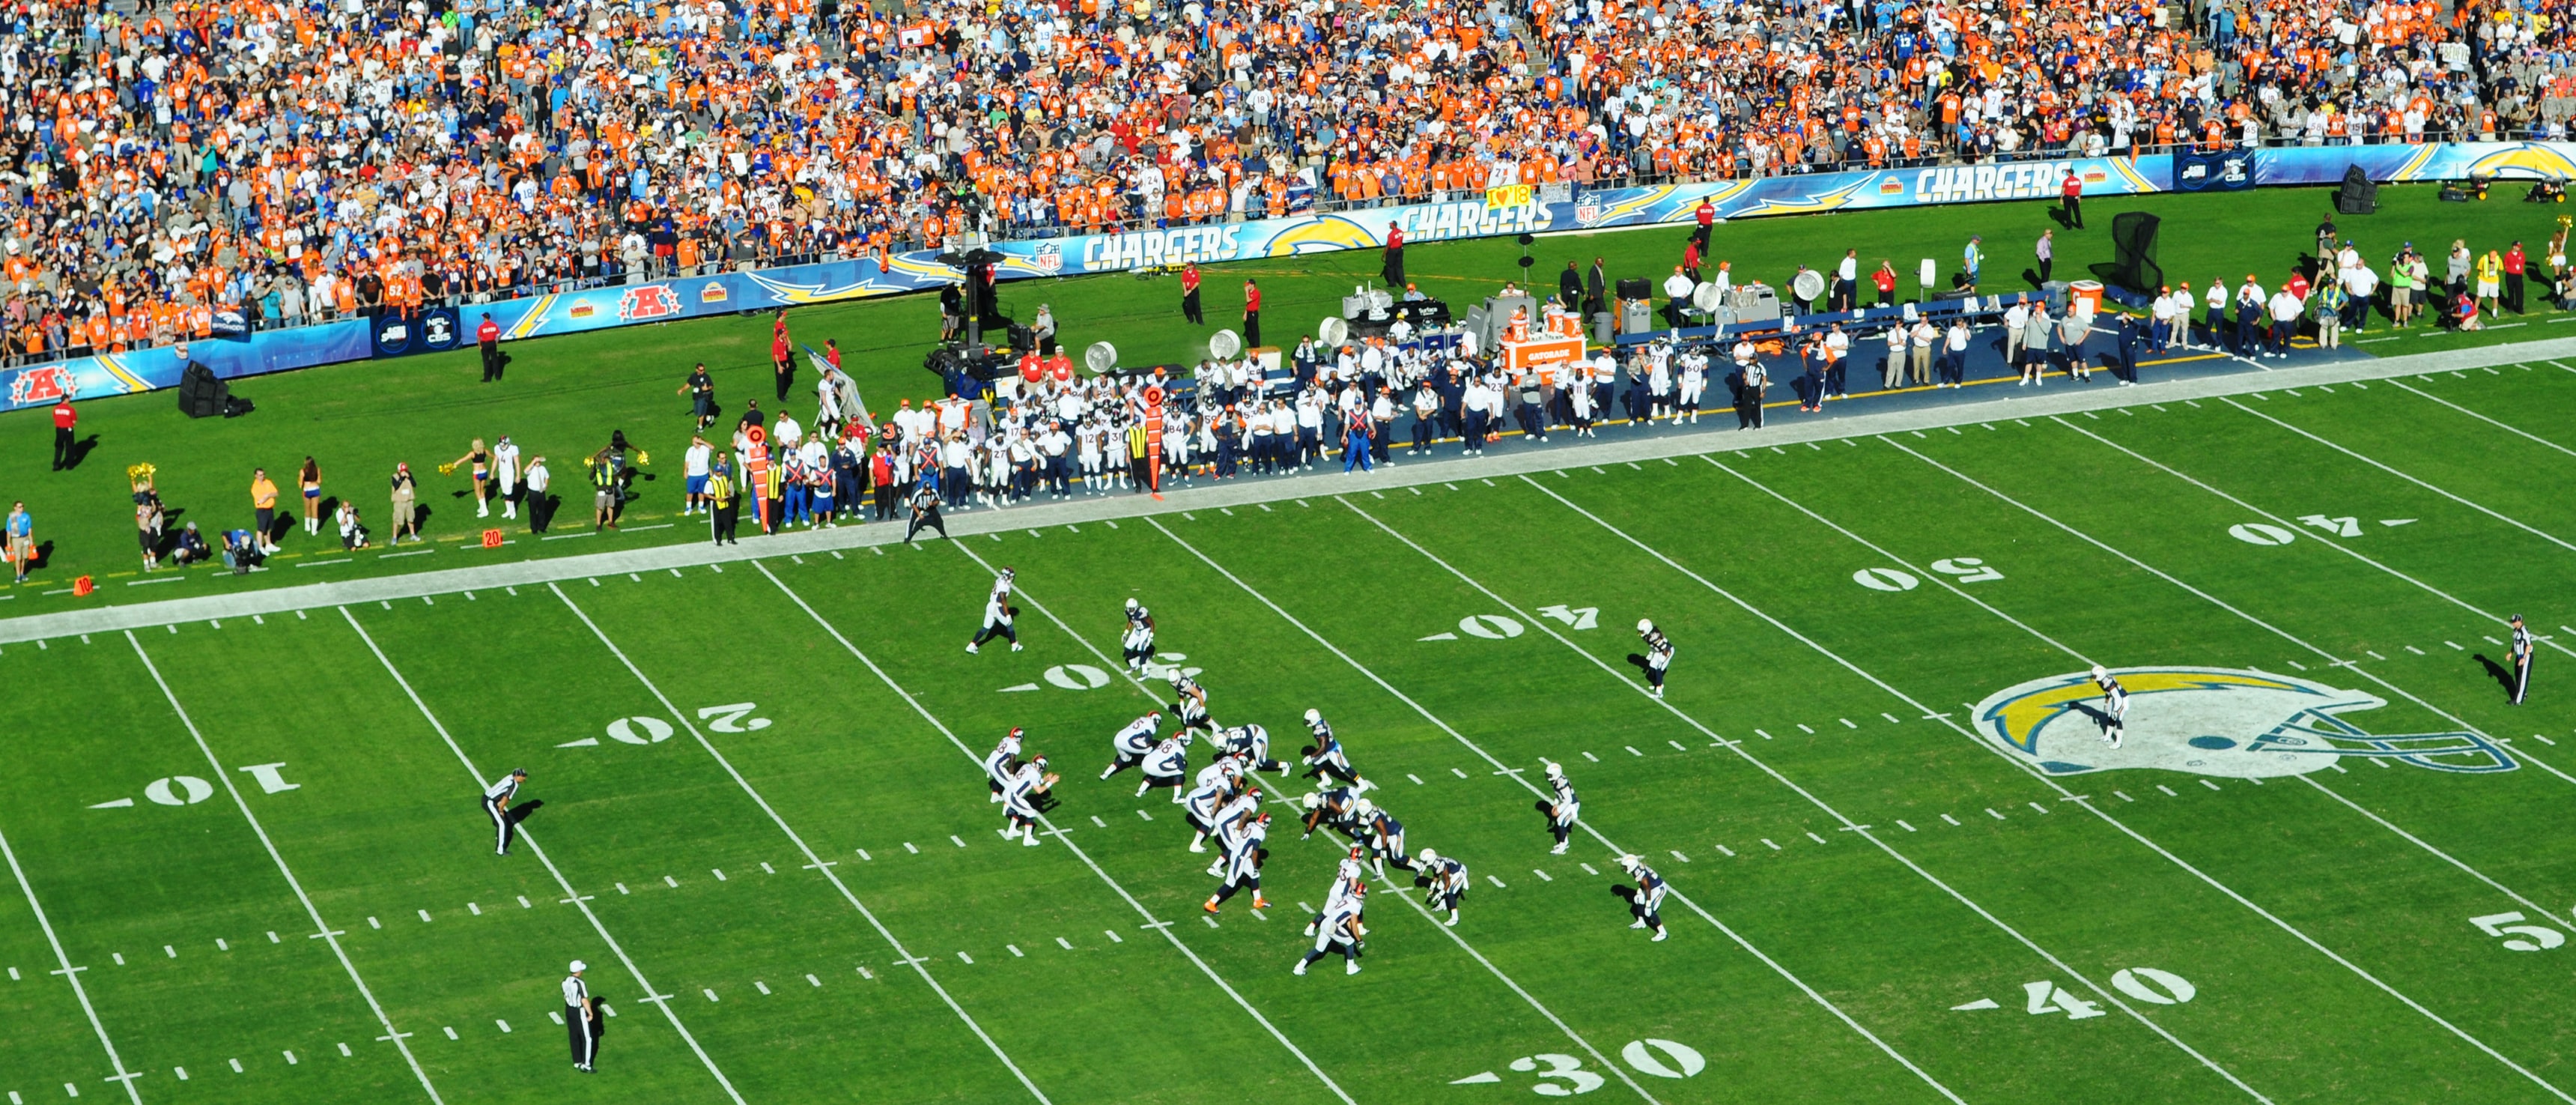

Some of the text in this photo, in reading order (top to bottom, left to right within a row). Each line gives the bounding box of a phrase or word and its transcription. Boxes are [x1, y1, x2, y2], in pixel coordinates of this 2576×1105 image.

[1901, 37, 1911, 47] 13
[2297, 55, 2310, 65] 77
[464, 64, 476, 73] 56
[2063, 74, 2074, 83] 24
[2246, 126, 2256, 134] 65
[1979, 135, 1990, 145] 18
[1617, 164, 1627, 175] 24
[1916, 162, 2072, 202] CHARGERS
[2226, 173, 2245, 181] CBS
[523, 189, 532, 198] 18
[1579, 208, 1597, 221] NFL
[270, 235, 282, 247] 15
[428, 234, 437, 245] 8
[1084, 225, 1241, 270] CHARGERS
[1040, 257, 1060, 267] NFL
[449, 272, 460, 283] 18
[477, 270, 486, 282] 18
[389, 285, 402, 296] 52
[631, 286, 668, 319] A
[212, 323, 246, 331] BRONCOS
[426, 318, 449, 327] NFL
[428, 333, 451, 343] CBS
[1528, 349, 1570, 361] GATORADE
[1686, 365, 1699, 373] 60
[25, 367, 64, 402] A
[1490, 384, 1502, 392] 23
[882, 423, 896, 441] 3
[1010, 427, 1019, 437] 17
[1170, 425, 1182, 434] 84
[1085, 434, 1094, 443] 12
[1112, 432, 1122, 442] 31
[994, 450, 1005, 458] 27
[2229, 515, 2363, 545] 40
[486, 531, 499, 546] 20
[1853, 558, 2004, 591] 50
[79, 578, 91, 593] 10
[1459, 605, 1599, 639] 40
[607, 703, 771, 744] 20
[145, 763, 300, 805] 10
[2469, 905, 2576, 951] 5
[2023, 967, 2196, 1019] 40
[1510, 1038, 1705, 1096] 30
